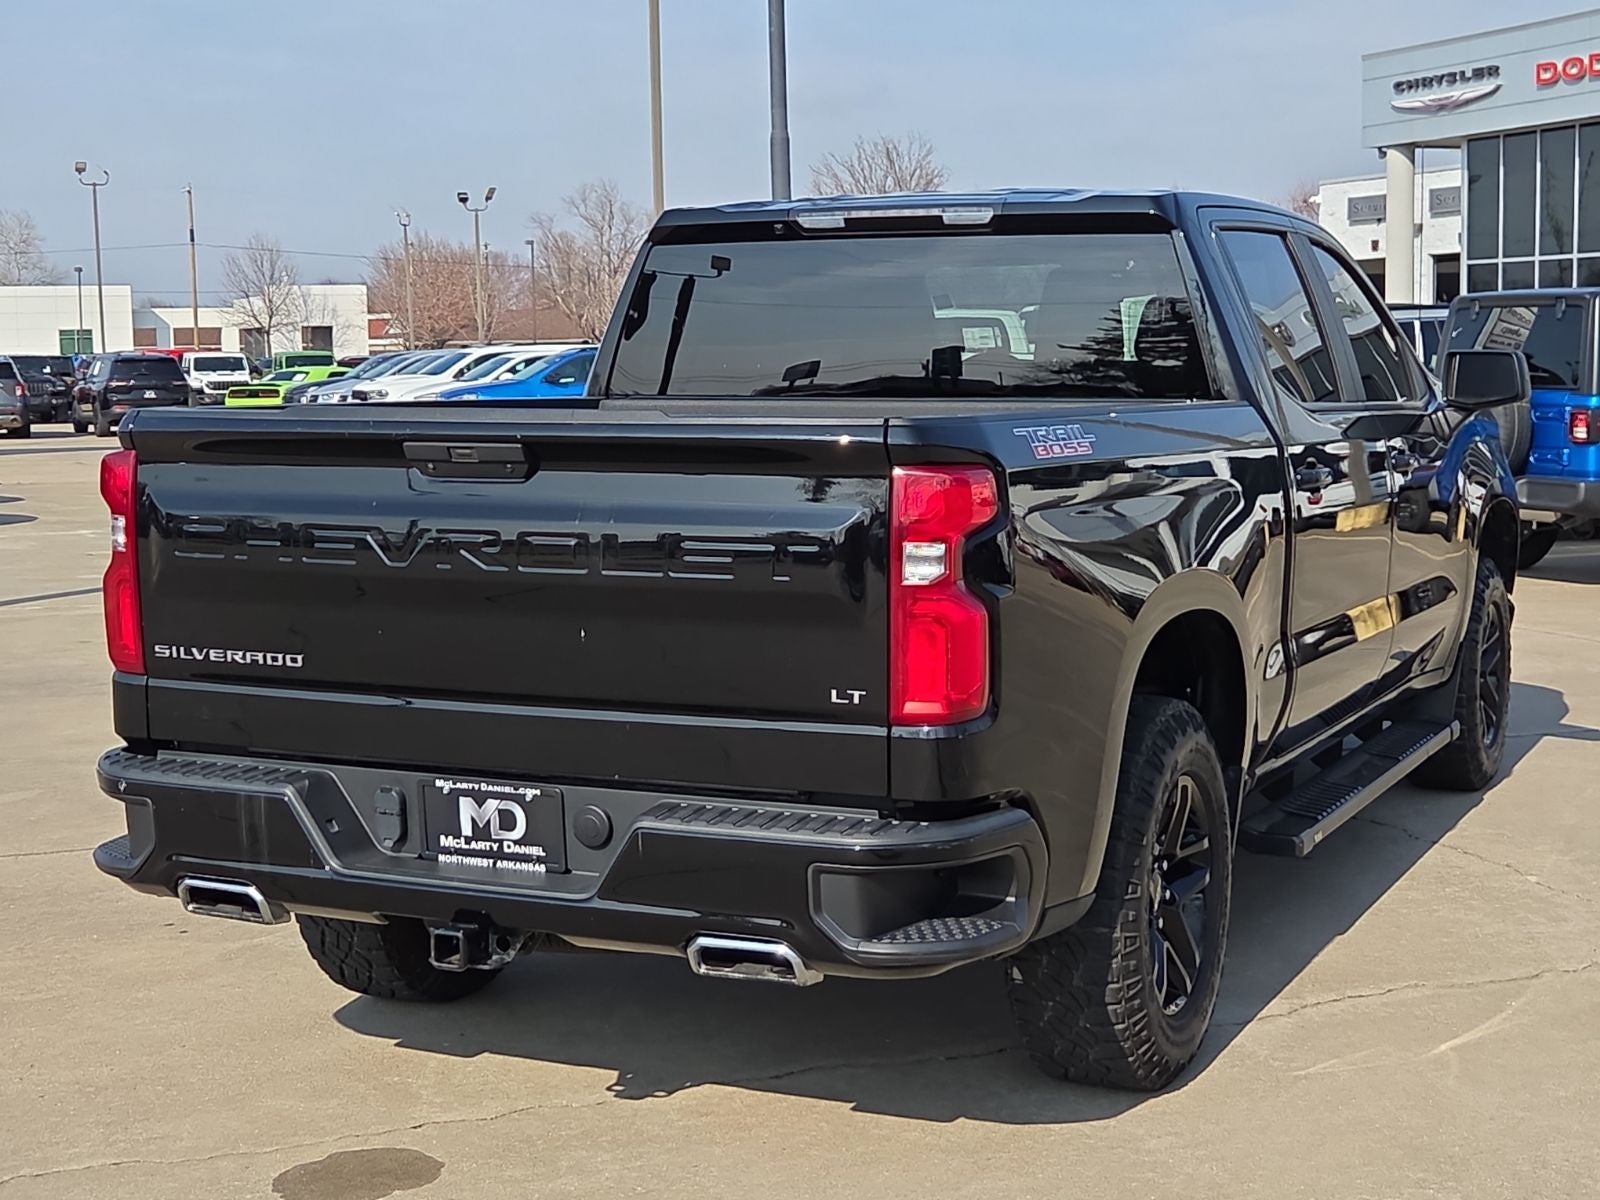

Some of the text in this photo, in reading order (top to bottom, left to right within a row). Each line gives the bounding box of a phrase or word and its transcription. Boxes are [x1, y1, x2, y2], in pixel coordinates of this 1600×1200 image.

[1393, 65, 1500, 92] CHRYSLER
[1013, 424, 1097, 444] TRAIL
[1033, 441, 1093, 459] BOSS
[154, 644, 305, 668] SILVERADO
[830, 688, 866, 705] LT
[458, 796, 527, 841] MD
[502, 840, 547, 856] DANIEL
[438, 853, 547, 872] NORTHWEST ARKANSAS
